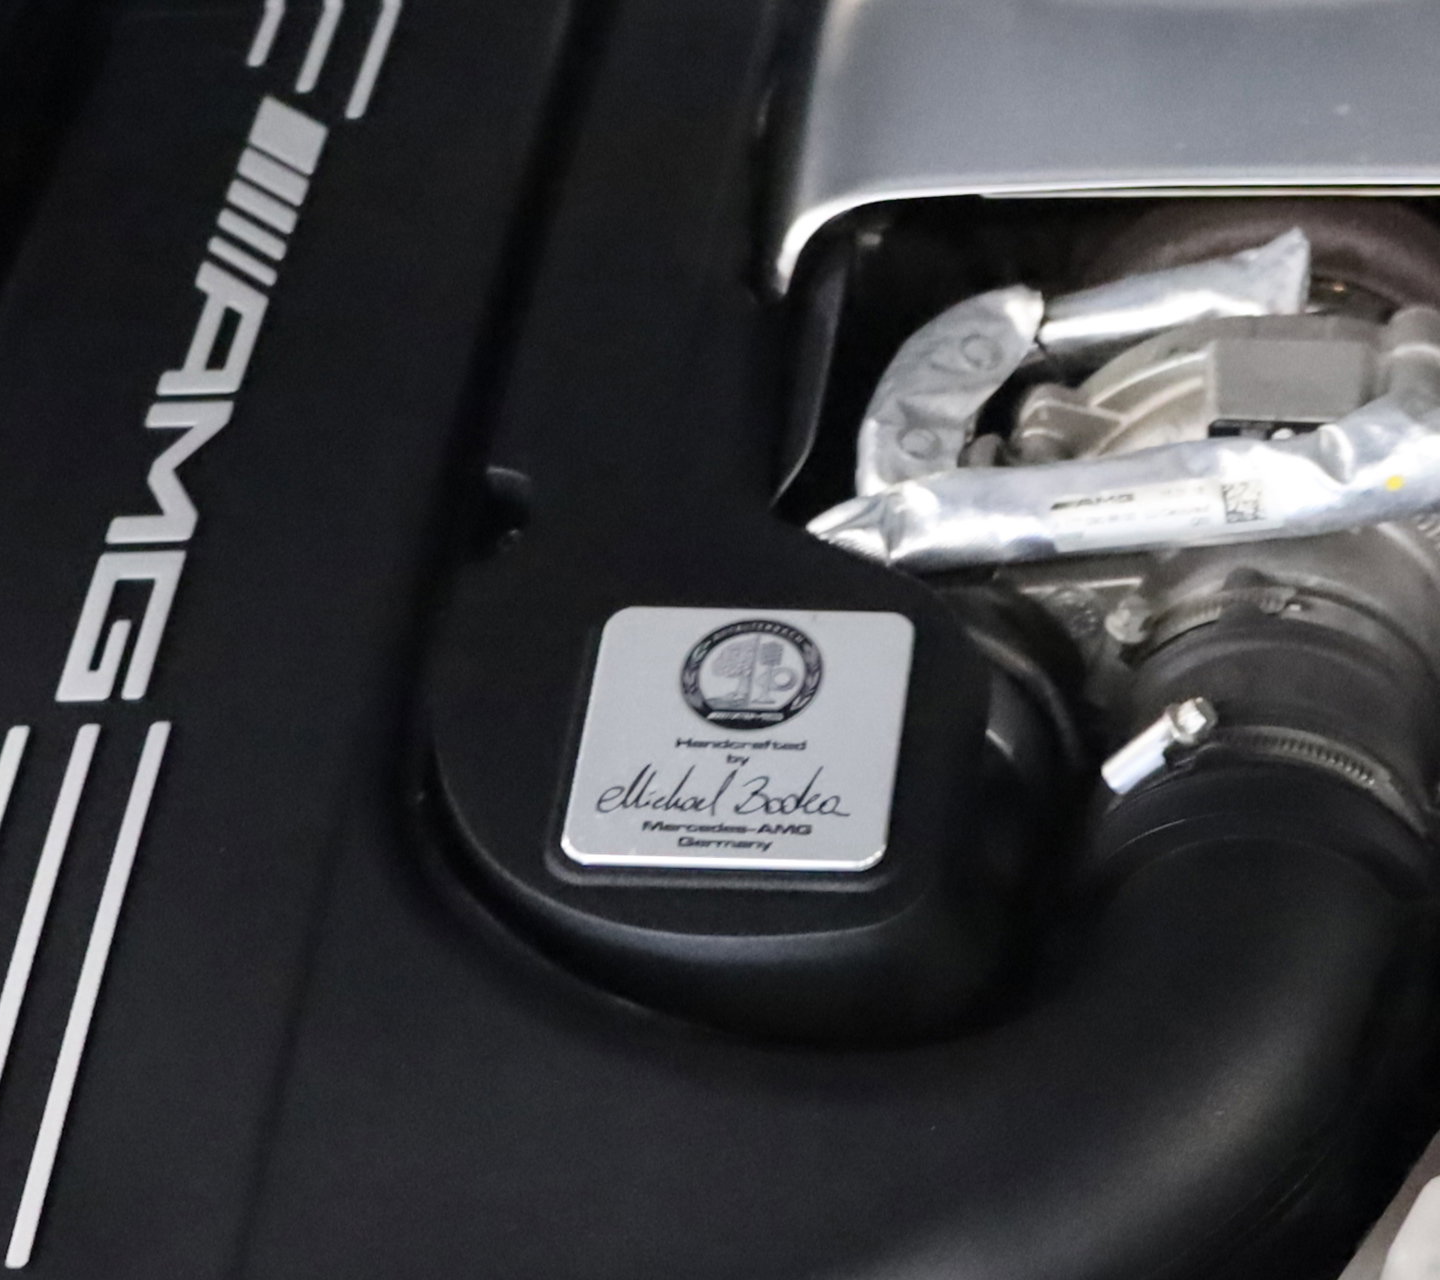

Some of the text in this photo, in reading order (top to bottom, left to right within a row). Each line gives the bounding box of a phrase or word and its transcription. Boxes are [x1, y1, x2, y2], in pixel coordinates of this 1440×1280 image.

[56, 261, 269, 702] AMG
[674, 737, 807, 751] Handcrafted
[725, 753, 750, 767] by
[641, 820, 813, 836] Mercedes-AMG
[677, 836, 774, 852] Germany
